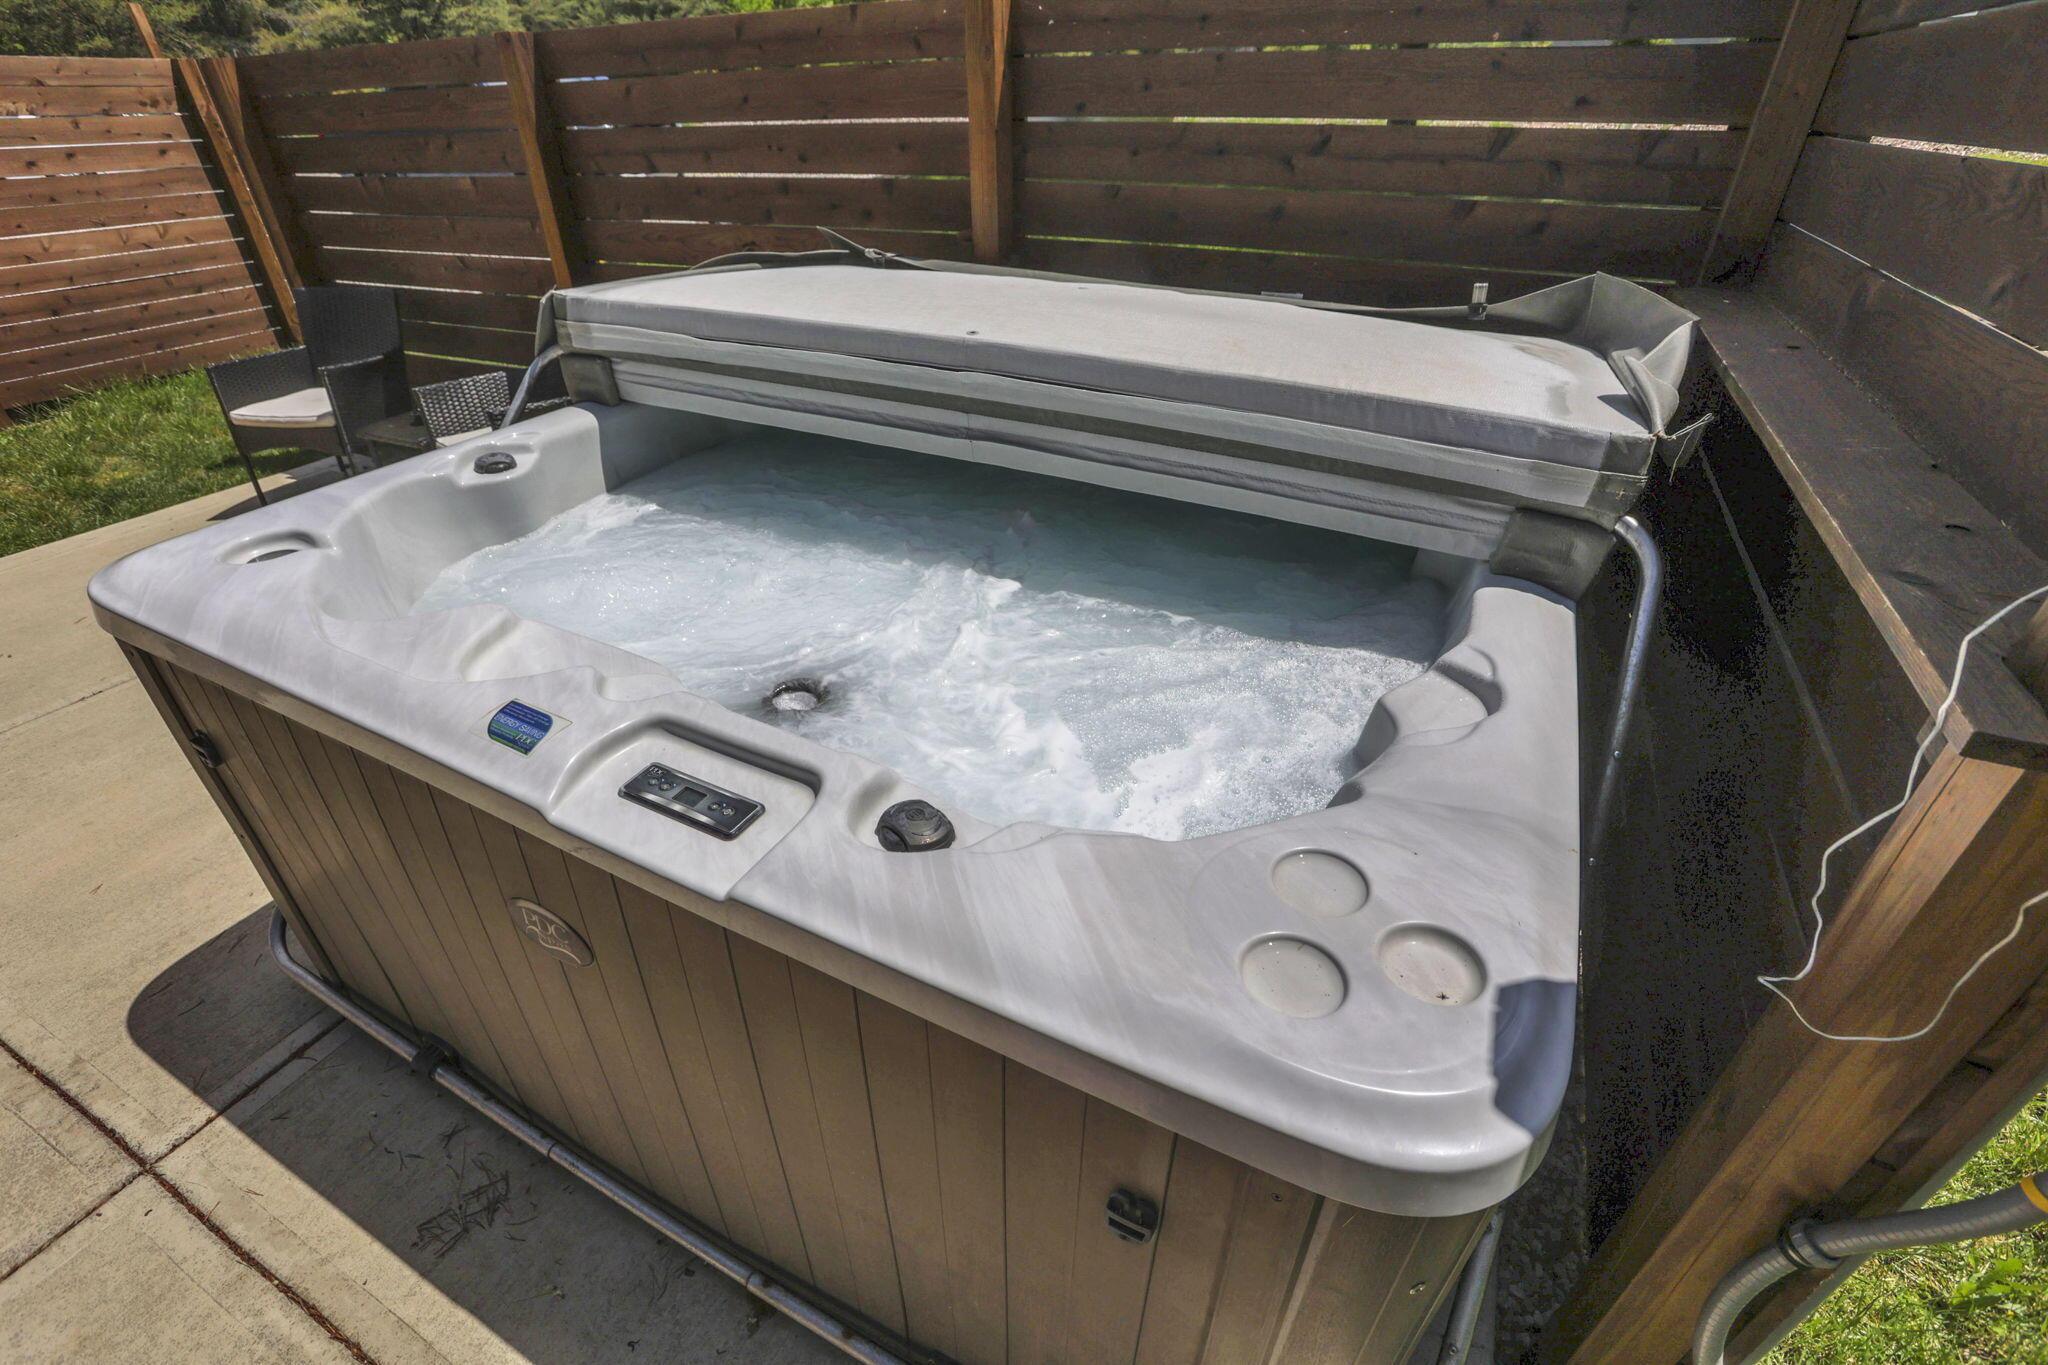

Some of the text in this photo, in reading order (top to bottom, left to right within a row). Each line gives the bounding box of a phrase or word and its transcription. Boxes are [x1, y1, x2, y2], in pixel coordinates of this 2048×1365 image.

[494, 713, 520, 728] ENERGY
[519, 724, 545, 739] SAVING
[522, 908, 568, 944] PDC
